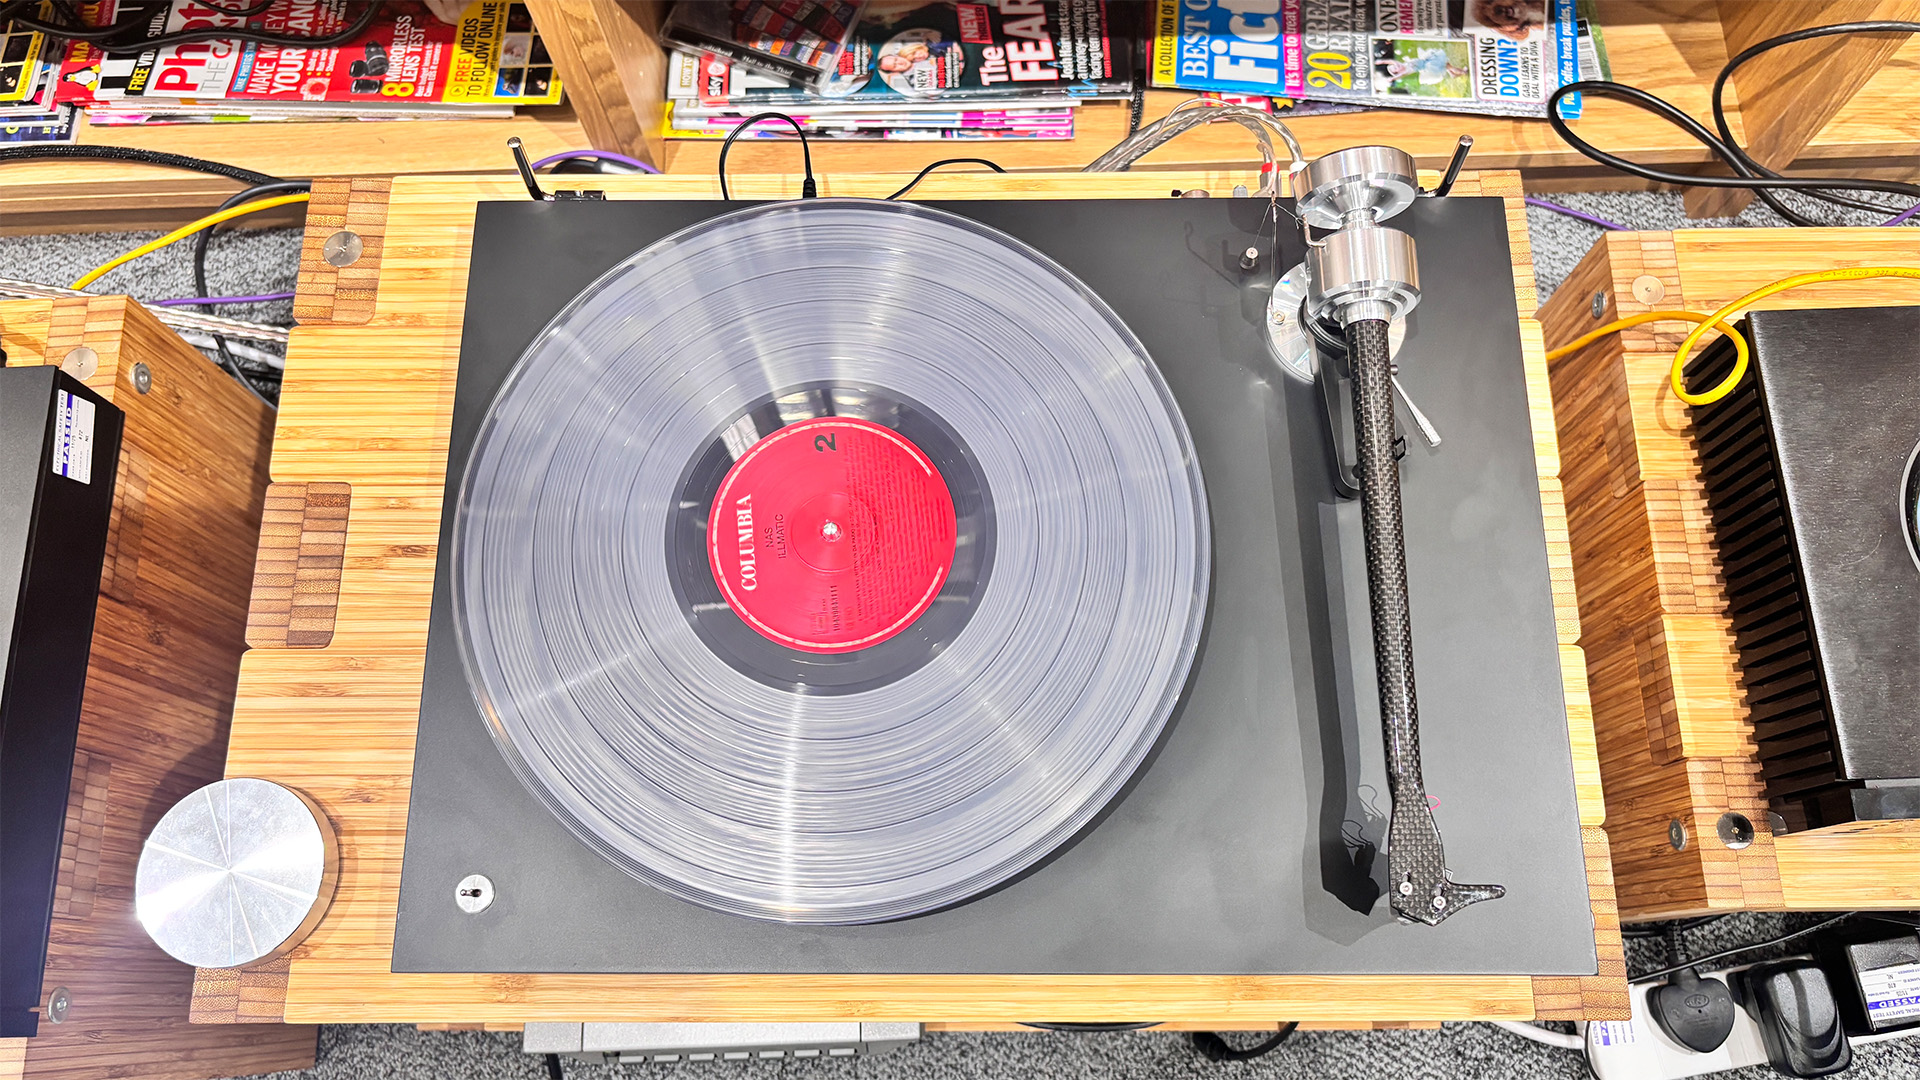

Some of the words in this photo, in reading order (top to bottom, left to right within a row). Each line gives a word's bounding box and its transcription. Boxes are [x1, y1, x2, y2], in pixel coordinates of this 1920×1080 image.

[479, 2, 497, 38] ONLINE
[1161, 4, 1174, 15] OF
[1354, 8, 1365, 32] relax
[1558, 6, 1574, 36] puzzles,
[960, 8, 978, 39] NEW
[975, 7, 989, 40] THRILLER
[1284, 11, 1298, 34] treat
[385, 15, 412, 81] MIRRORLESS
[407, 27, 425, 53] TEST
[459, 18, 479, 55] VIDEOS
[1058, 17, 1073, 57] Hartnett
[1160, 18, 1174, 66] COLLECTION
[1182, 16, 1210, 78] BEST
[1285, 36, 1298, 47] to
[1353, 34, 1366, 52] and
[1530, 41, 1538, 56] DIVA
[1560, 38, 1573, 59] break
[470, 41, 492, 81] FOLLOW
[1284, 48, 1299, 71] time
[1520, 47, 1528, 55] TO
[200, 61, 229, 92] THE
[238, 53, 254, 76] PHOTOS
[270, 48, 307, 94] YOUR
[401, 56, 421, 82] LENS
[454, 58, 472, 82] FREE
[741, 55, 757, 65] Hail
[775, 65, 794, 77] Thief
[979, 47, 1009, 86] The
[1059, 57, 1074, 80] Josh
[1088, 52, 1103, 79] facing
[1306, 52, 1352, 90] 20
[1353, 53, 1369, 78] enjoy
[1479, 38, 1498, 95] DRESSING
[1497, 38, 1520, 97] DOWN?
[1520, 56, 1530, 80] LEARNS
[1530, 64, 1538, 80] WITH
[1561, 61, 1574, 83] Coffee
[128, 68, 150, 91] FREE
[247, 62, 276, 93] MAKE
[381, 82, 414, 97] 8
[681, 69, 692, 86] HOW
[707, 76, 724, 96] sky
[917, 69, 927, 88] NEW
[1285, 72, 1300, 87] It's
[1353, 80, 1367, 90] To
[466, 85, 482, 96] TO
[1522, 82, 1531, 98] GABI
[1531, 83, 1540, 99] DEAL
[63, 407, 72, 464] PASSED
[814, 433, 836, 452] 2
[736, 494, 757, 591] COLUMBIA
[764, 527, 774, 548] NAS
[775, 514, 787, 559] ILLMATIC
